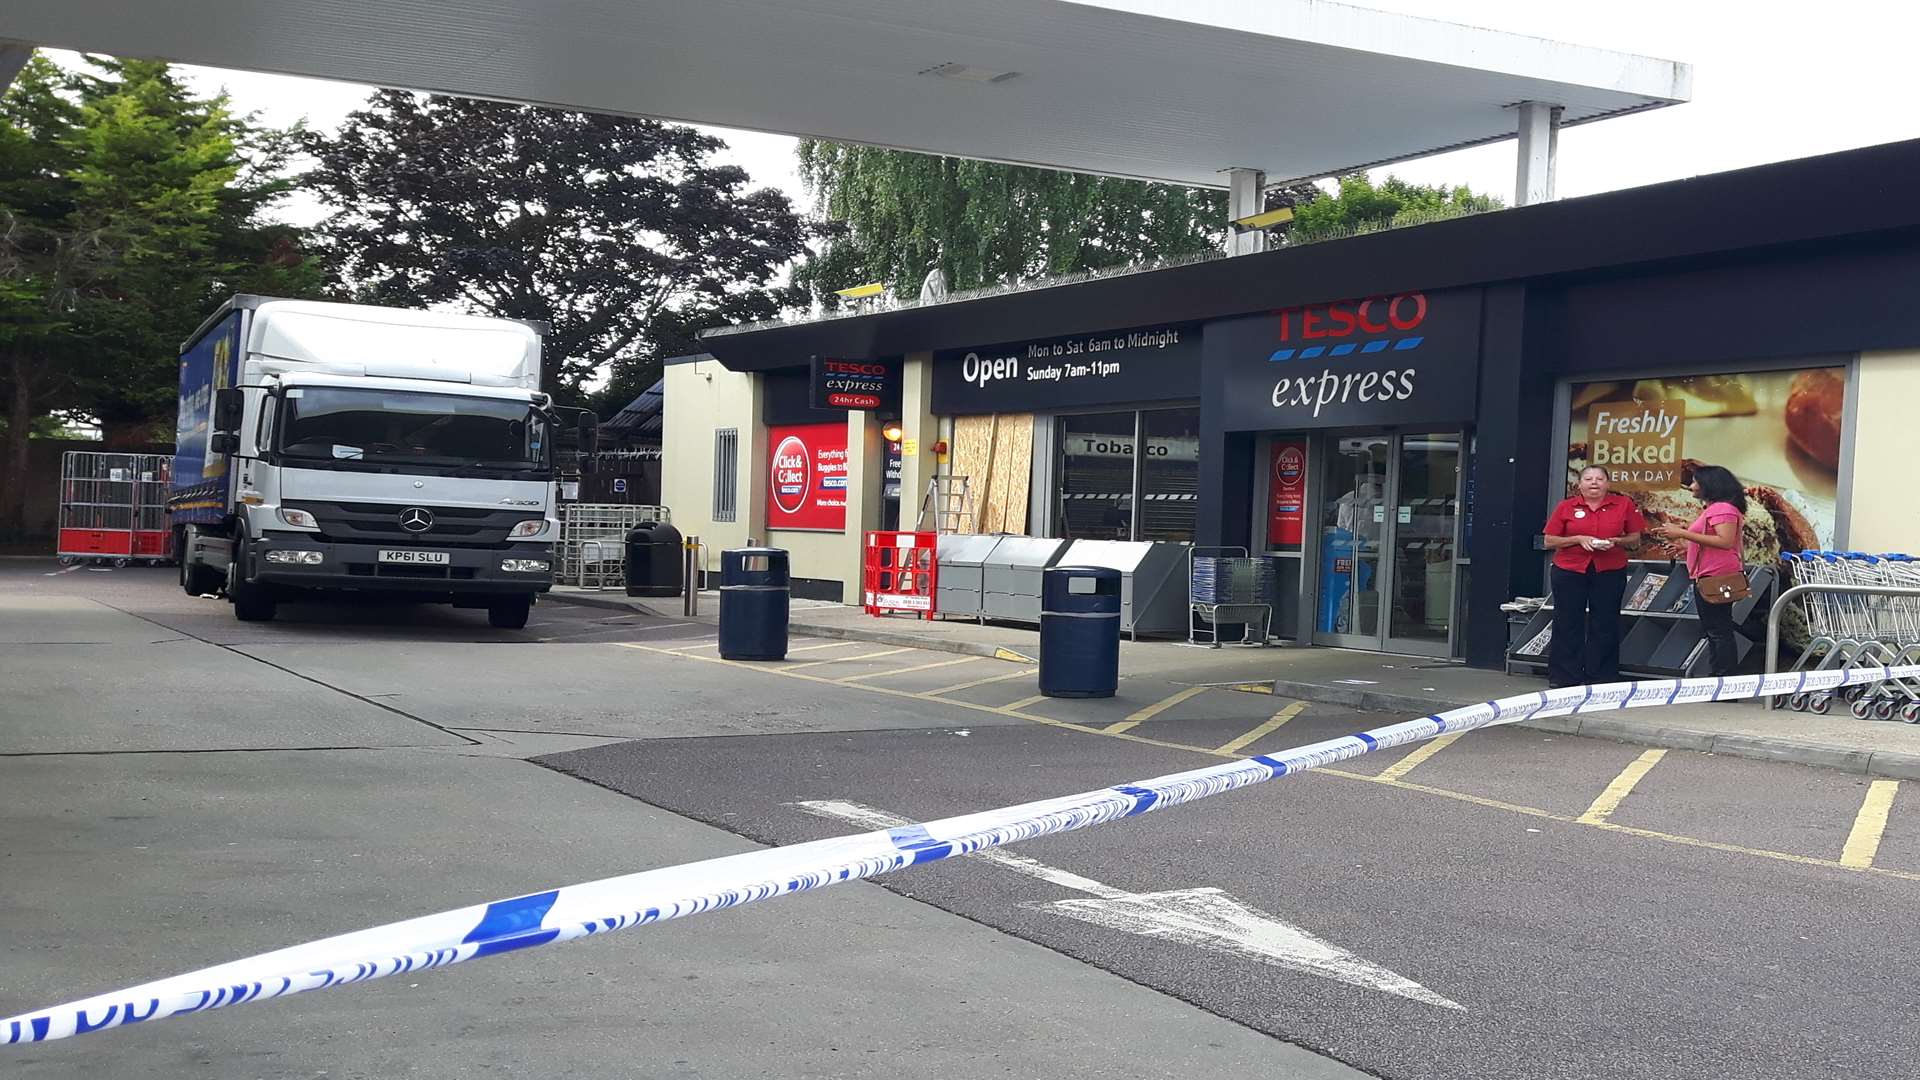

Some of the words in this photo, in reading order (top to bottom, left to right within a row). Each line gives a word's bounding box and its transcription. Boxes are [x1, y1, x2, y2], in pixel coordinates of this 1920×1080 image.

[1277, 291, 1427, 341] TESCO
[1028, 345, 1049, 358] Mon
[1053, 344, 1063, 356] to
[1066, 341, 1084, 355] Sat
[1088, 338, 1111, 352] 6am
[1114, 336, 1125, 349] to
[1127, 330, 1179, 349] Midnight
[827, 361, 885, 374] TESCO
[963, 352, 1018, 388] Open
[1027, 364, 1062, 381] Sunday
[1064, 361, 1120, 378] 7am-11pm
[826, 380, 883, 392] express
[1271, 369, 1416, 418] express
[834, 396, 853, 404] 24hr
[1594, 409, 1678, 438] Freshly
[1083, 439, 1168, 456] Tobaco
[1593, 437, 1676, 465] Baked
[779, 456, 796, 469] Click
[778, 470, 802, 483] Collect
[1609, 471, 1640, 482] ERY
[1645, 470, 1674, 481] DAY
[386, 551, 415, 562] KP61
[416, 552, 443, 563] SLU
